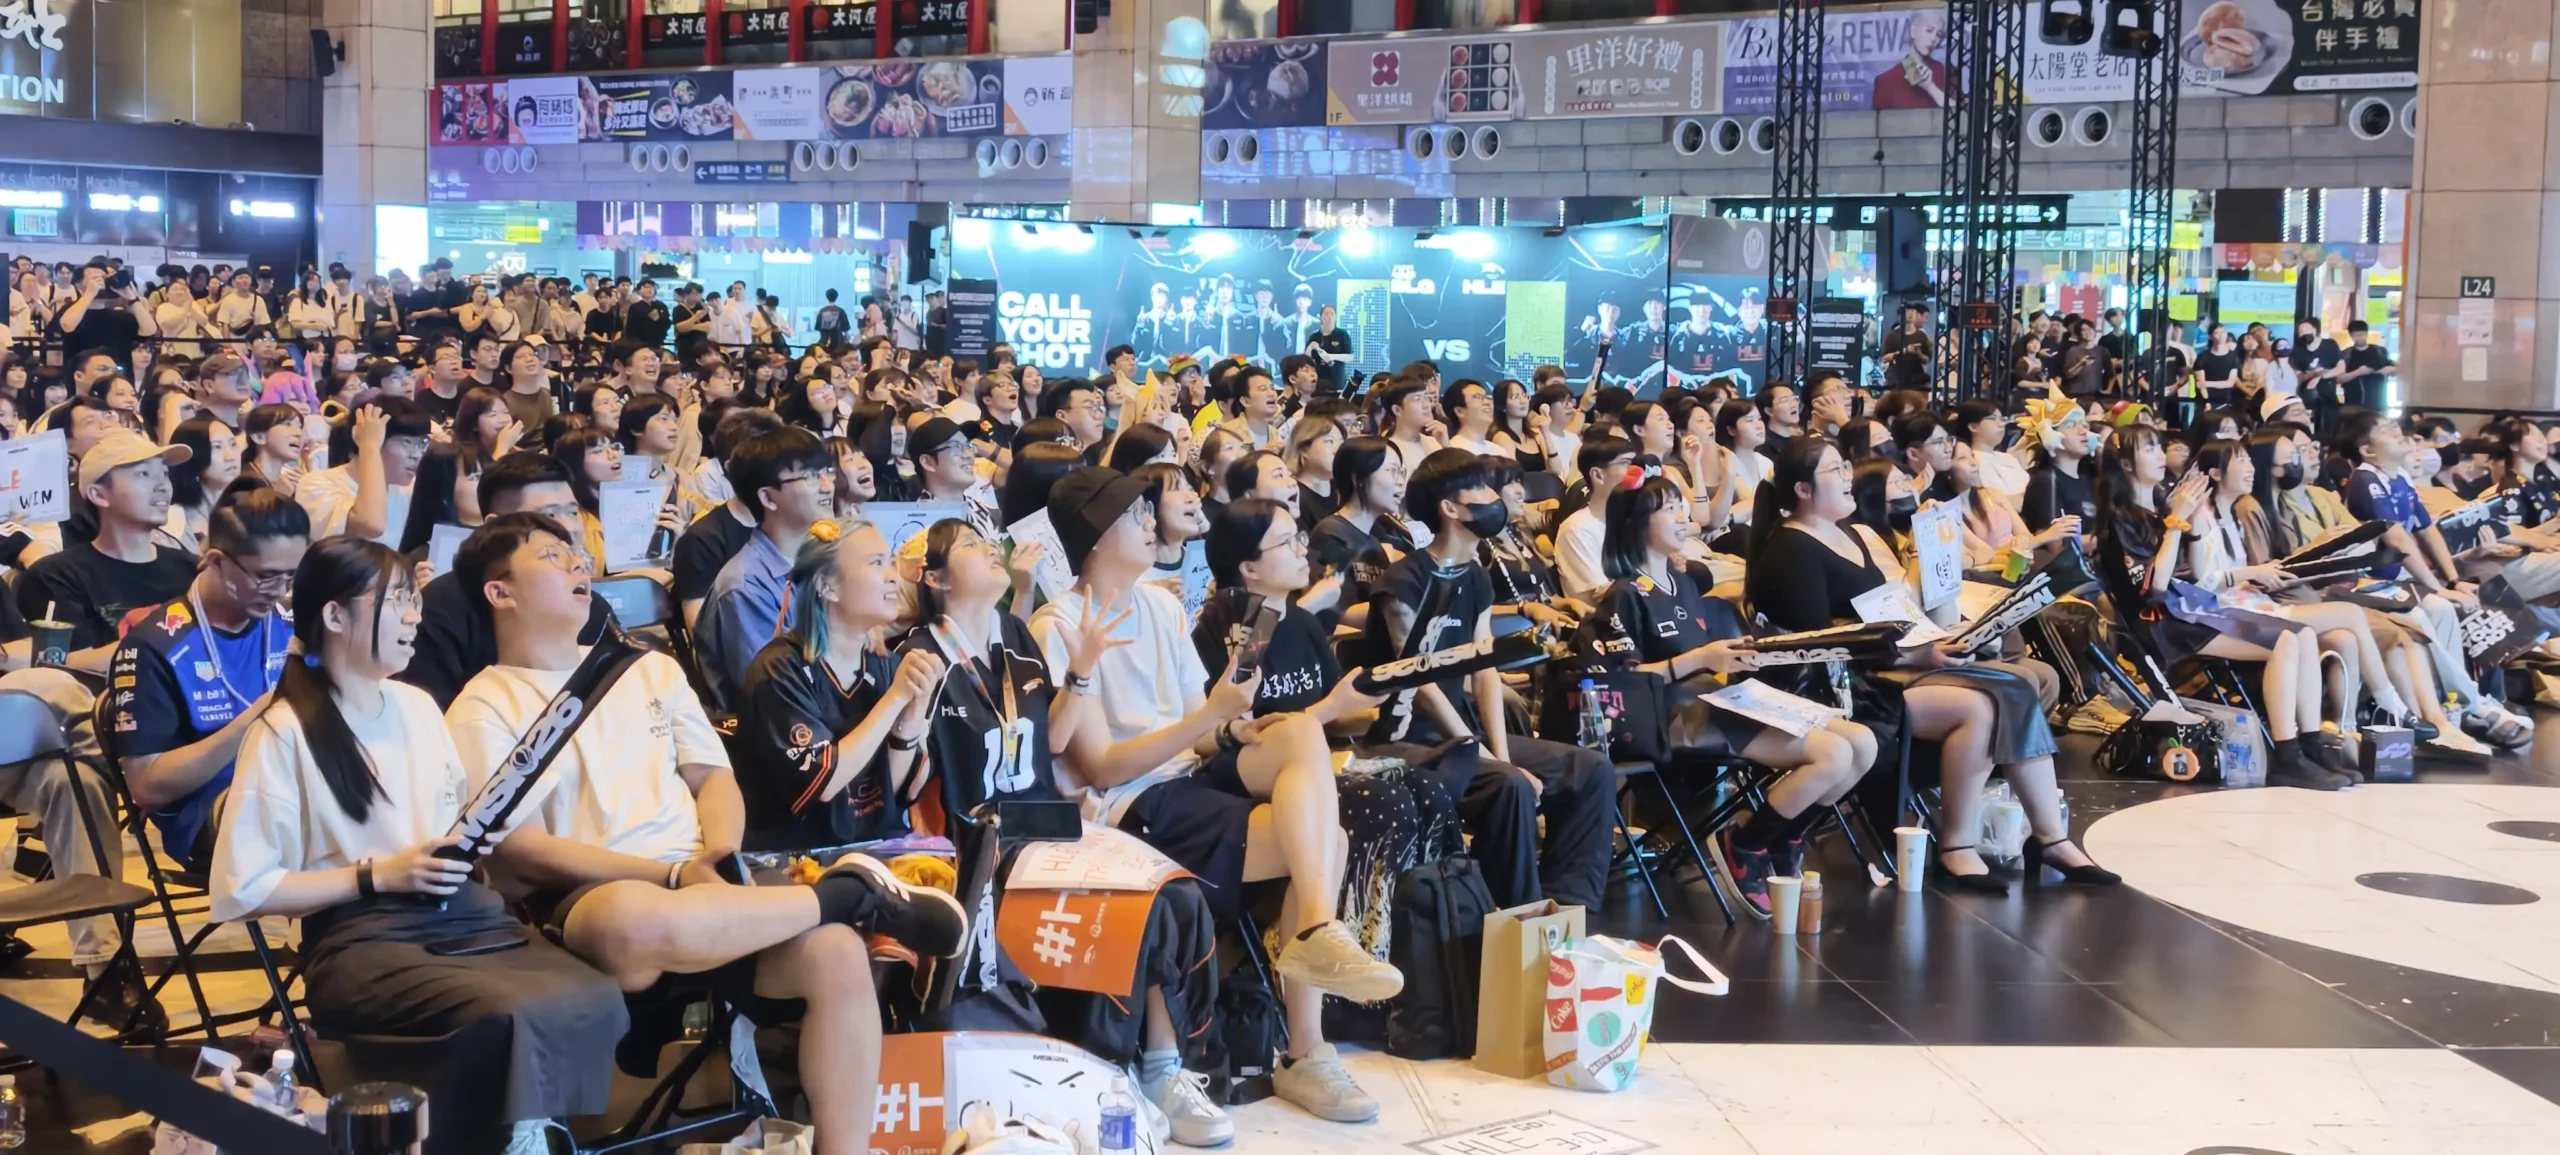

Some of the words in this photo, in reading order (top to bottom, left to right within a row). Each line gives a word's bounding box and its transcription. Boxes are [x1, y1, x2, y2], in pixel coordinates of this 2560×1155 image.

[2315, 25, 2400, 52] 伴手禮
[1566, 35, 1685, 78] 里洋好禮
[2028, 51, 2130, 81] 太陽堂老店
[1330, 112, 1343, 123] 1F
[24, 172, 77, 189] Vending
[1462, 279, 1506, 295] HLE
[2463, 279, 2492, 297] L24
[998, 291, 1091, 319] CALL
[998, 317, 1091, 344] YOUR
[1423, 339, 1471, 362] VS
[20, 489, 52, 510] WIN
[197, 703, 233, 713] ORACLE
[941, 705, 968, 718] HLE
[1626, 975, 1647, 1005] Coke
[1550, 1000, 1573, 1030] Coke
[1589, 1054, 1611, 1077] TASTE
